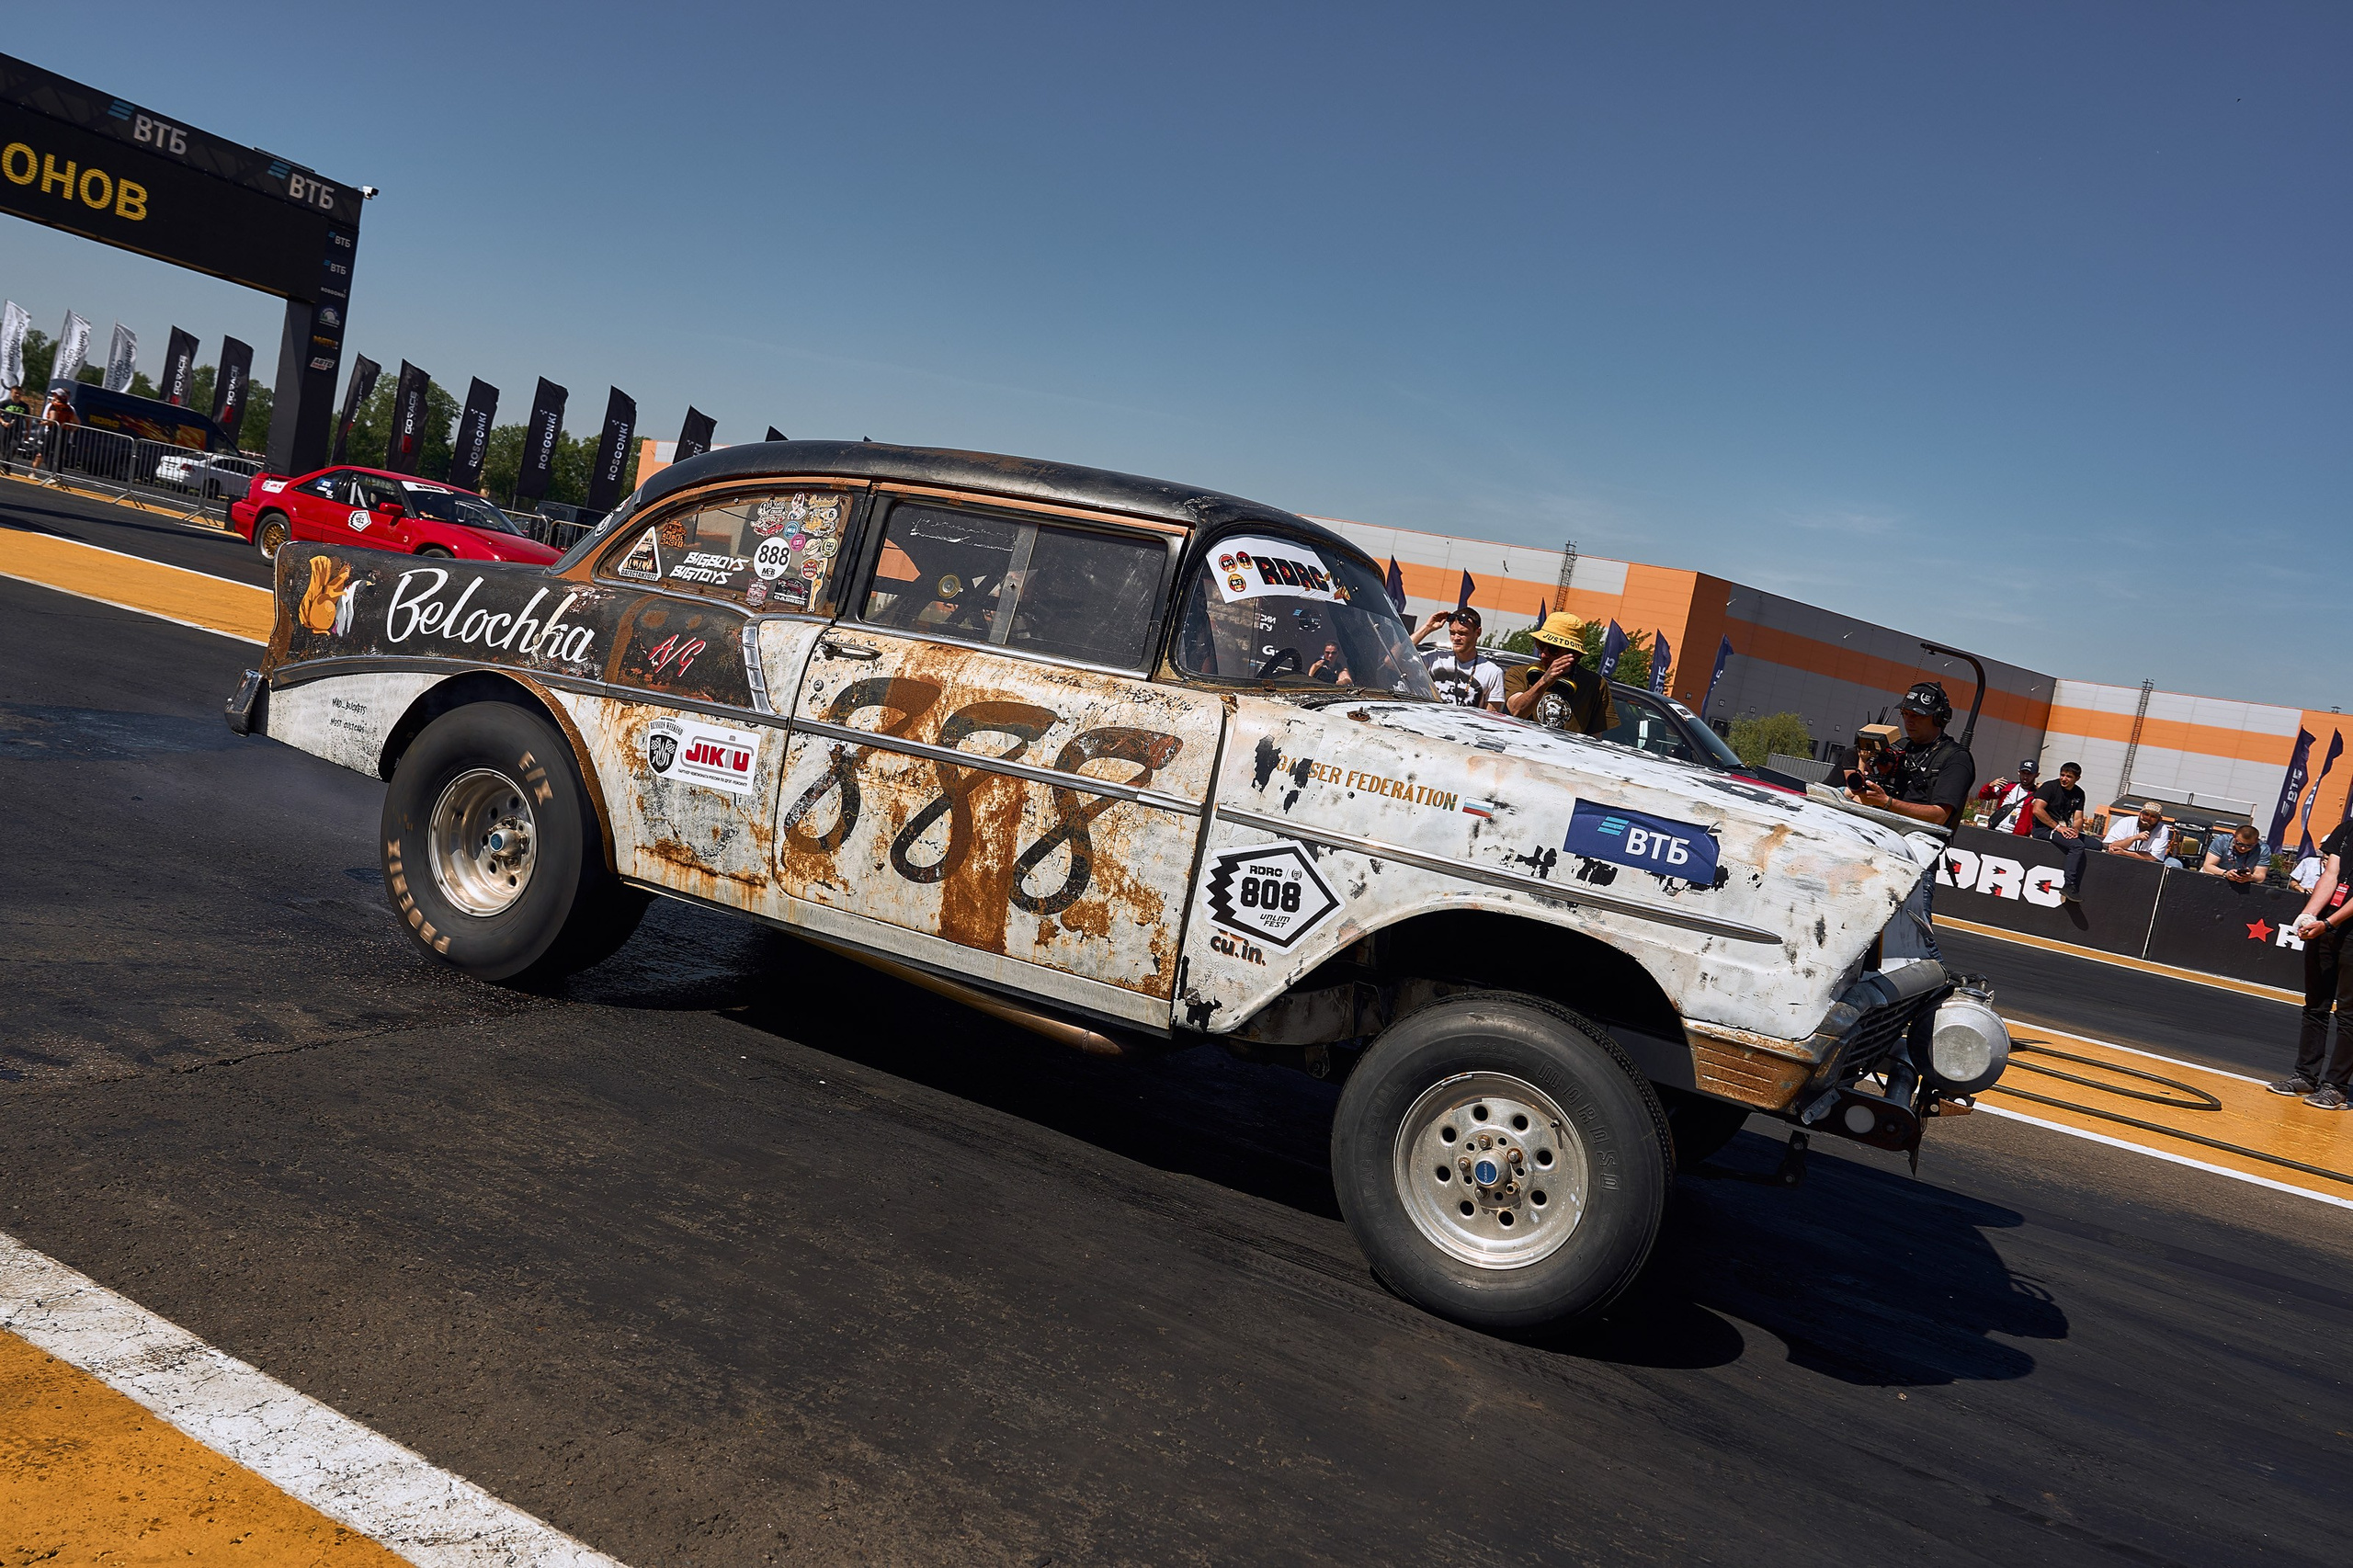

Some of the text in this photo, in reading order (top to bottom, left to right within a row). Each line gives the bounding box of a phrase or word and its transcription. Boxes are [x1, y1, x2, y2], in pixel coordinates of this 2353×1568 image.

[133, 113, 188, 155] ВТБ
[2, 142, 149, 221] ОНОВ
[289, 172, 335, 210] ВТБ
[335, 235, 351, 248] ВТБ
[330, 263, 347, 276] ВТБ
[468, 412, 487, 467] ROSGONKI
[538, 412, 557, 470] ROSGONKI
[608, 422, 629, 481] ROSGONKI
[683, 551, 750, 572] BIGBOYS
[757, 544, 790, 566] 888
[1251, 555, 1330, 593] RDRC
[668, 564, 733, 585] BIGTOYS
[386, 566, 596, 665] Belochka
[685, 743, 750, 772] JIKIU
[784, 676, 1184, 915] 888
[1276, 754, 1459, 812] GSER FEDERATION
[2287, 767, 2303, 803] ВТБ
[1625, 827, 1691, 866] ВТБ
[1249, 864, 1283, 878] RDRC
[1935, 846, 2066, 909] DRC
[1240, 876, 1302, 914] 808
[1263, 920, 1287, 928] FEST
[1537, 1060, 1620, 1192] MOROSO
